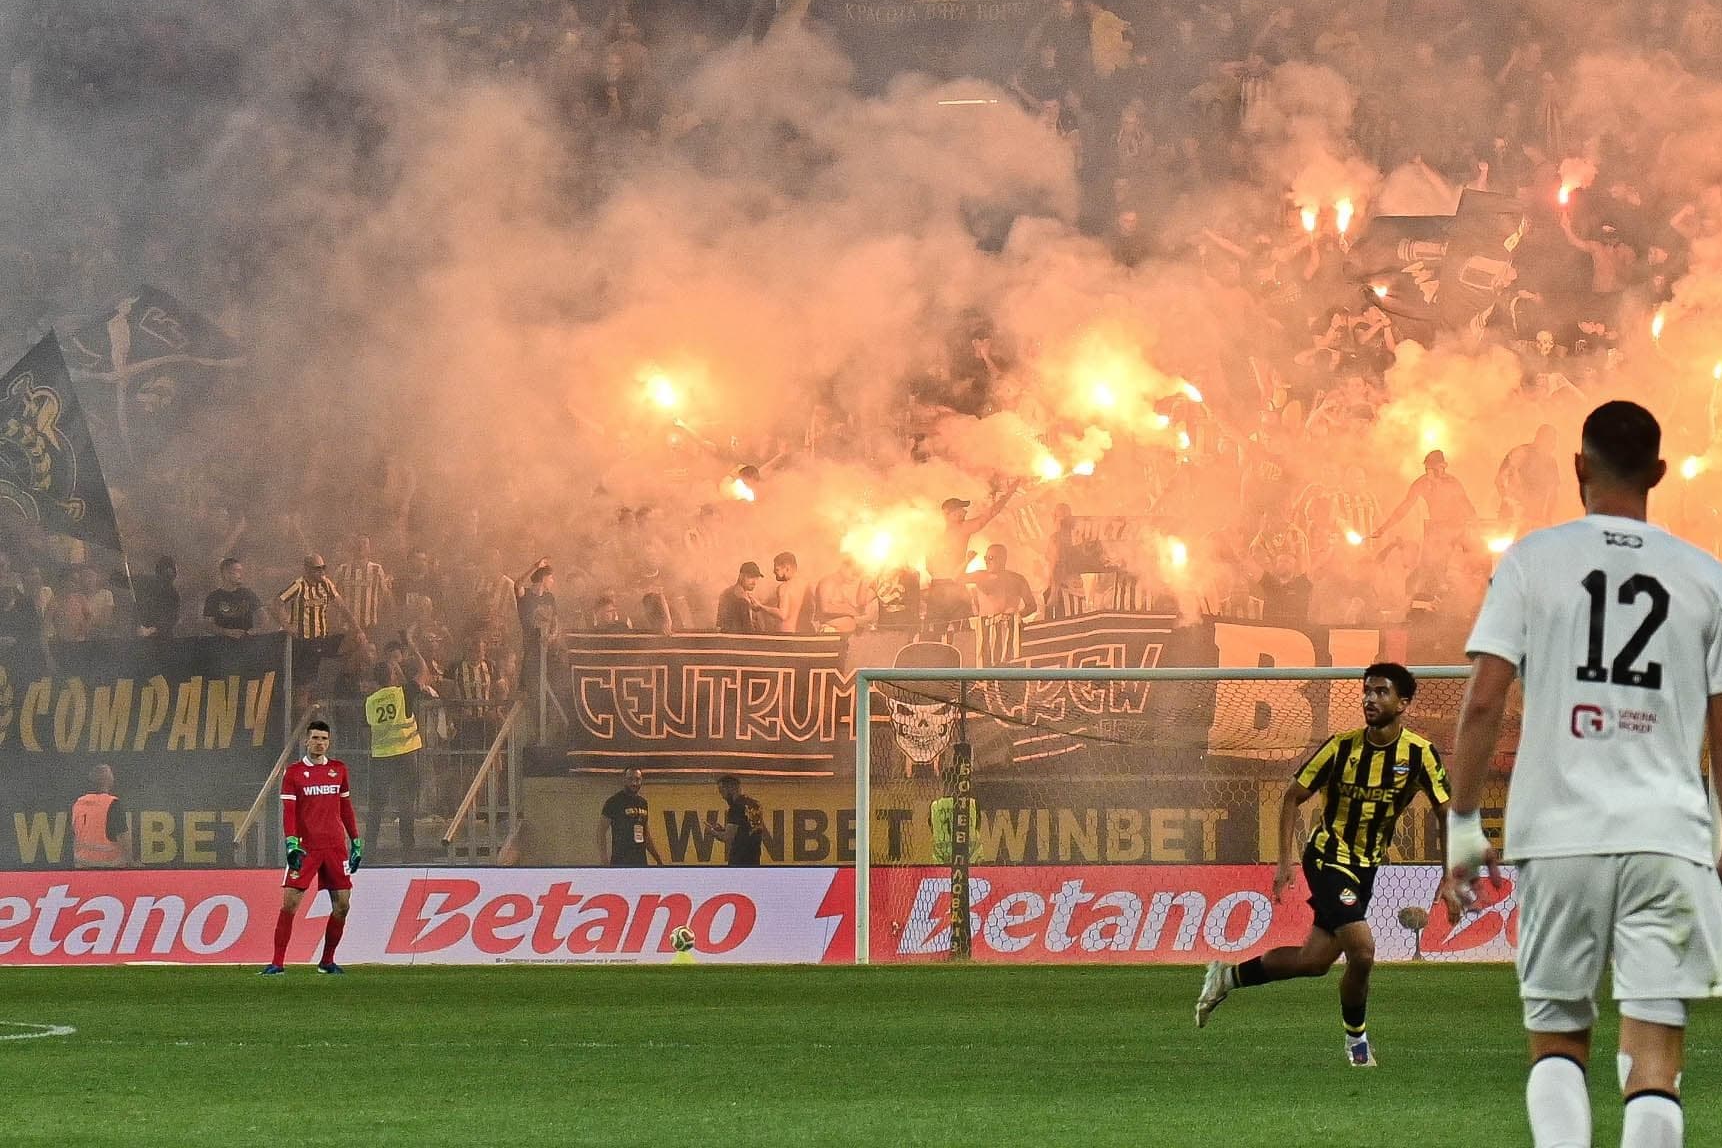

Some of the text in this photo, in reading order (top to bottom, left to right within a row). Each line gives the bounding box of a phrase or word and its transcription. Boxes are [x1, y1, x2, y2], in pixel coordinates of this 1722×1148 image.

[1576, 569, 1671, 690] 12
[19, 671, 277, 752] COMPANY
[375, 704, 397, 724] 29
[303, 784, 341, 796] WINBET
[13, 809, 253, 864] WBET
[663, 809, 914, 863] WNBET
[978, 808, 1229, 862] WINBET
[385, 879, 757, 955] Betano
[896, 878, 1273, 954] Betano
